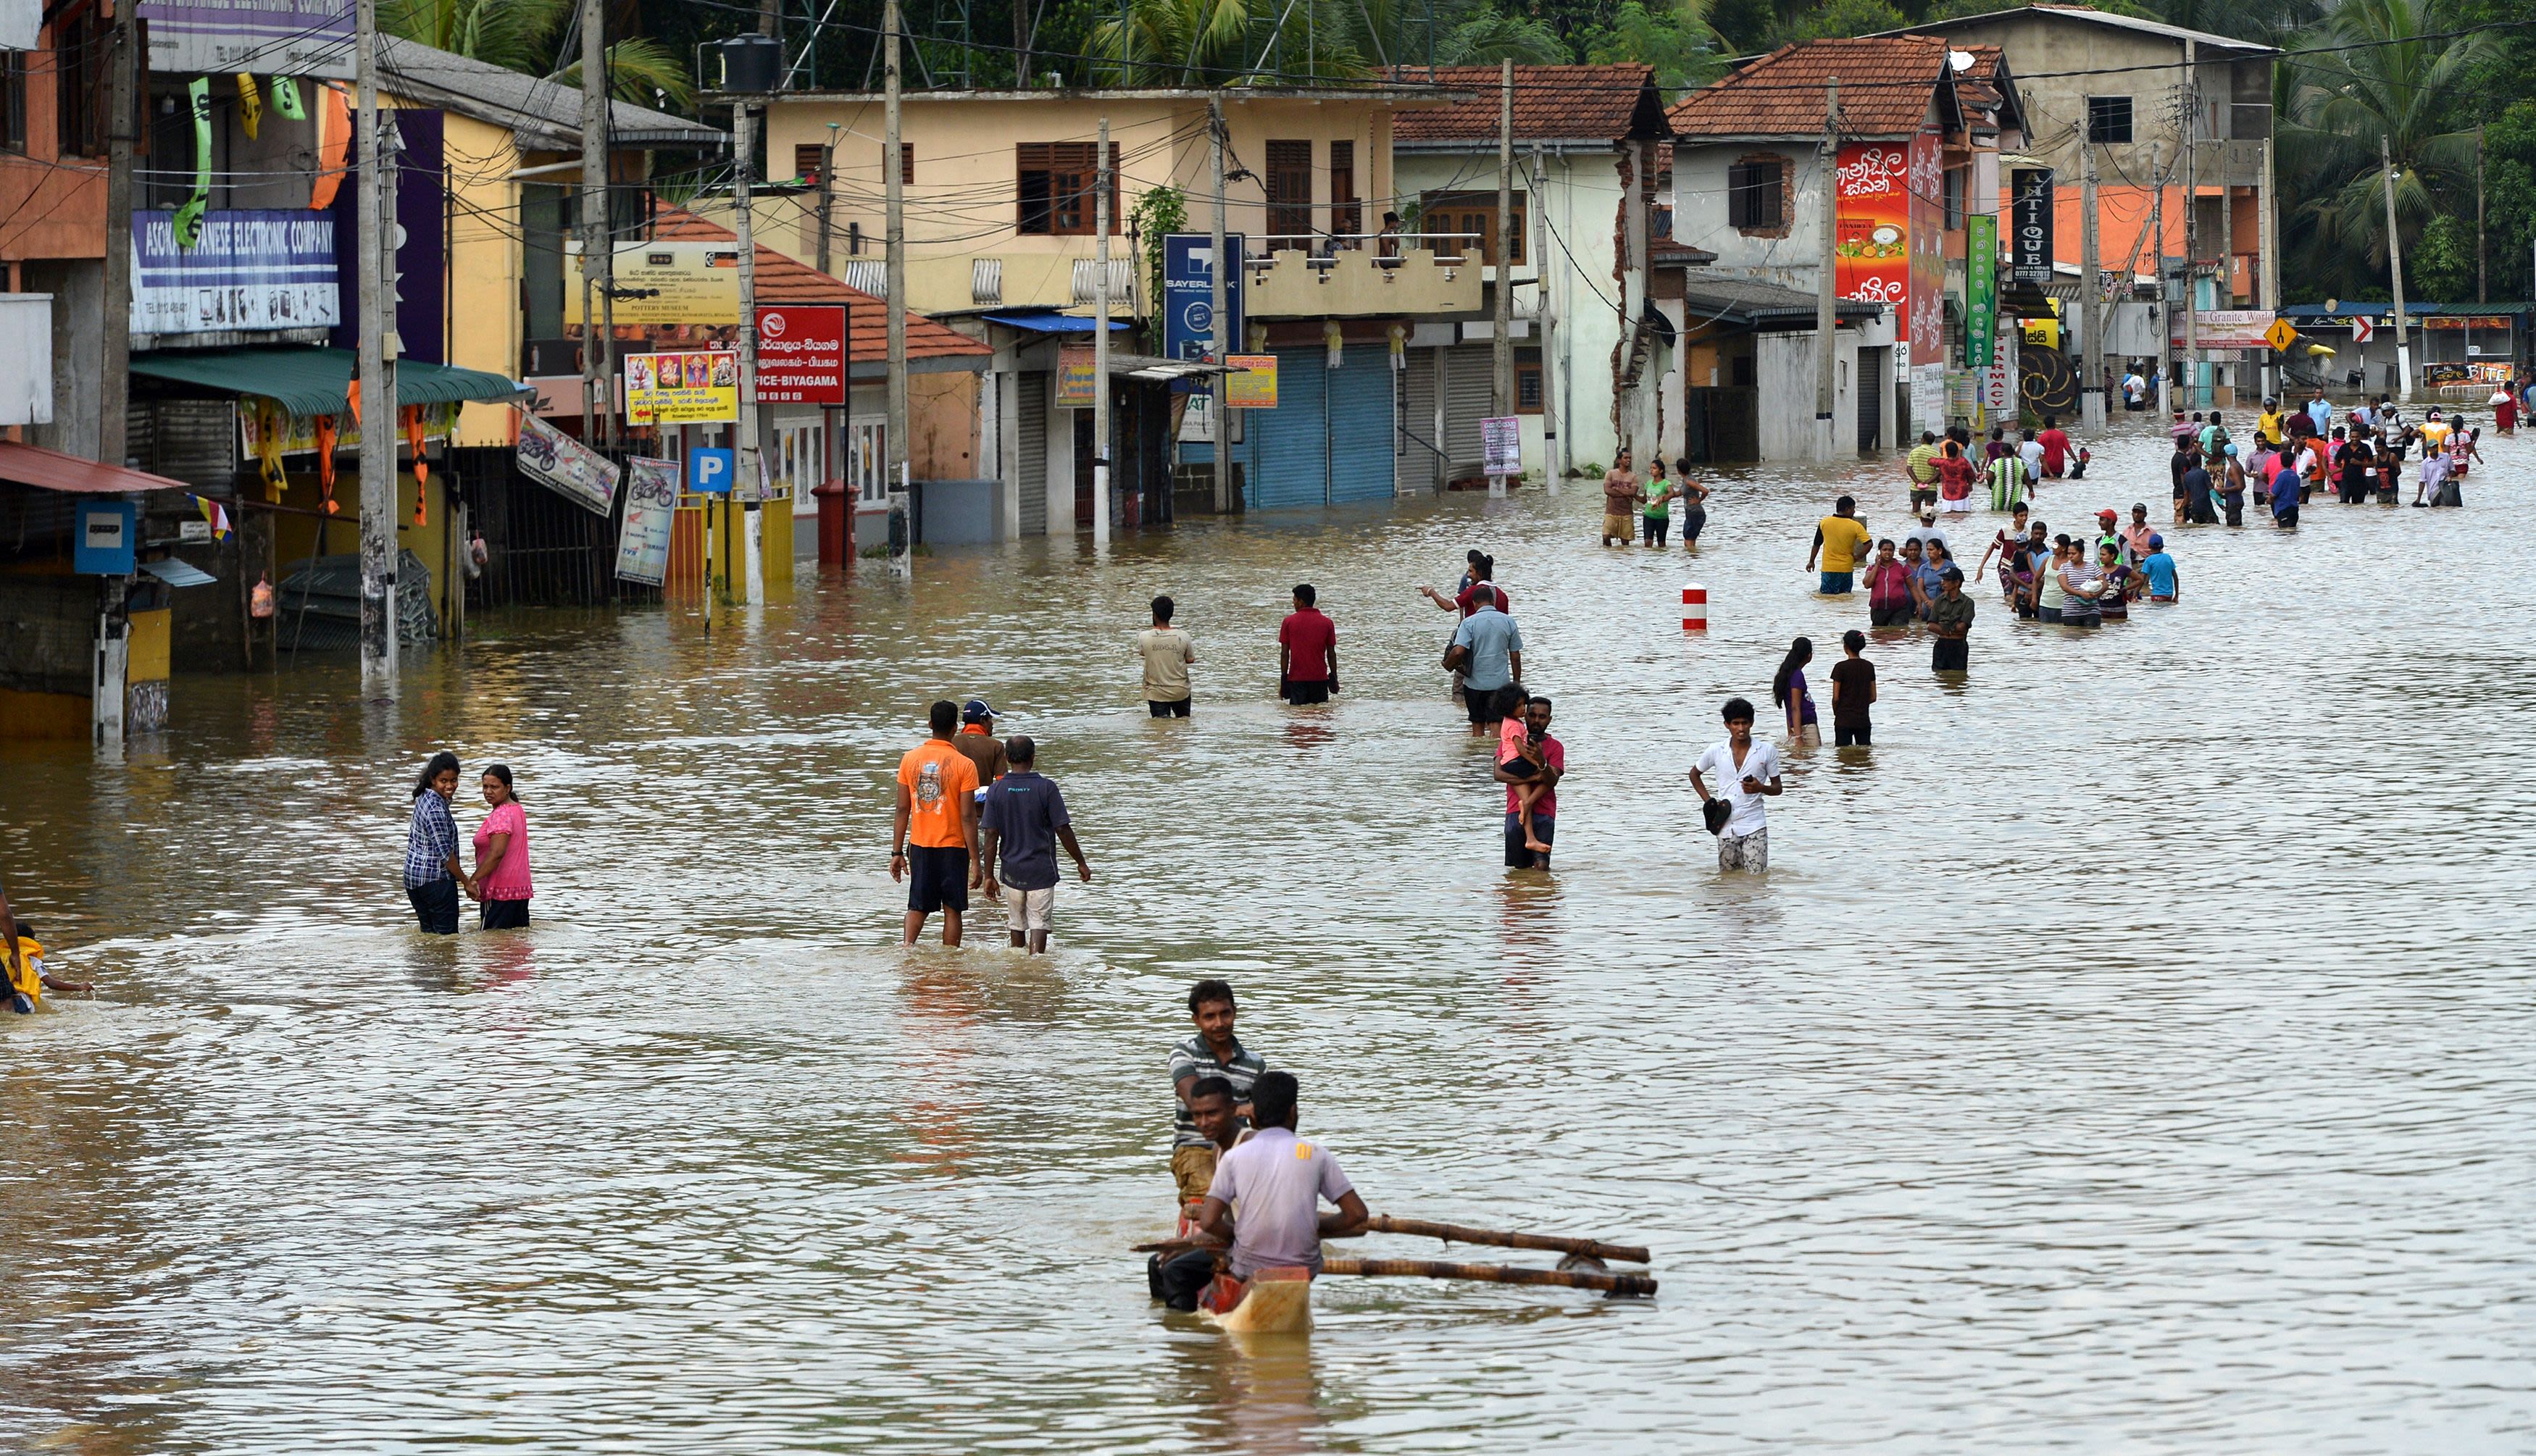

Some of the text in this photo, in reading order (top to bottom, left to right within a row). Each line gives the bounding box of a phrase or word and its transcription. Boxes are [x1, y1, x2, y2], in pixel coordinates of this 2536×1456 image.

[2022, 172, 2044, 265] ANTIQUE
[234, 220, 288, 254] ELECTRONIC
[291, 220, 333, 254] COMPANY
[1166, 280, 1235, 289] SAYERLK
[2210, 311, 2243, 322] Granite
[2247, 311, 2273, 322] World
[740, 375, 838, 386] FICE-BIYAGAMA
[2466, 364, 2506, 382] BITE
[699, 456, 723, 483] P
